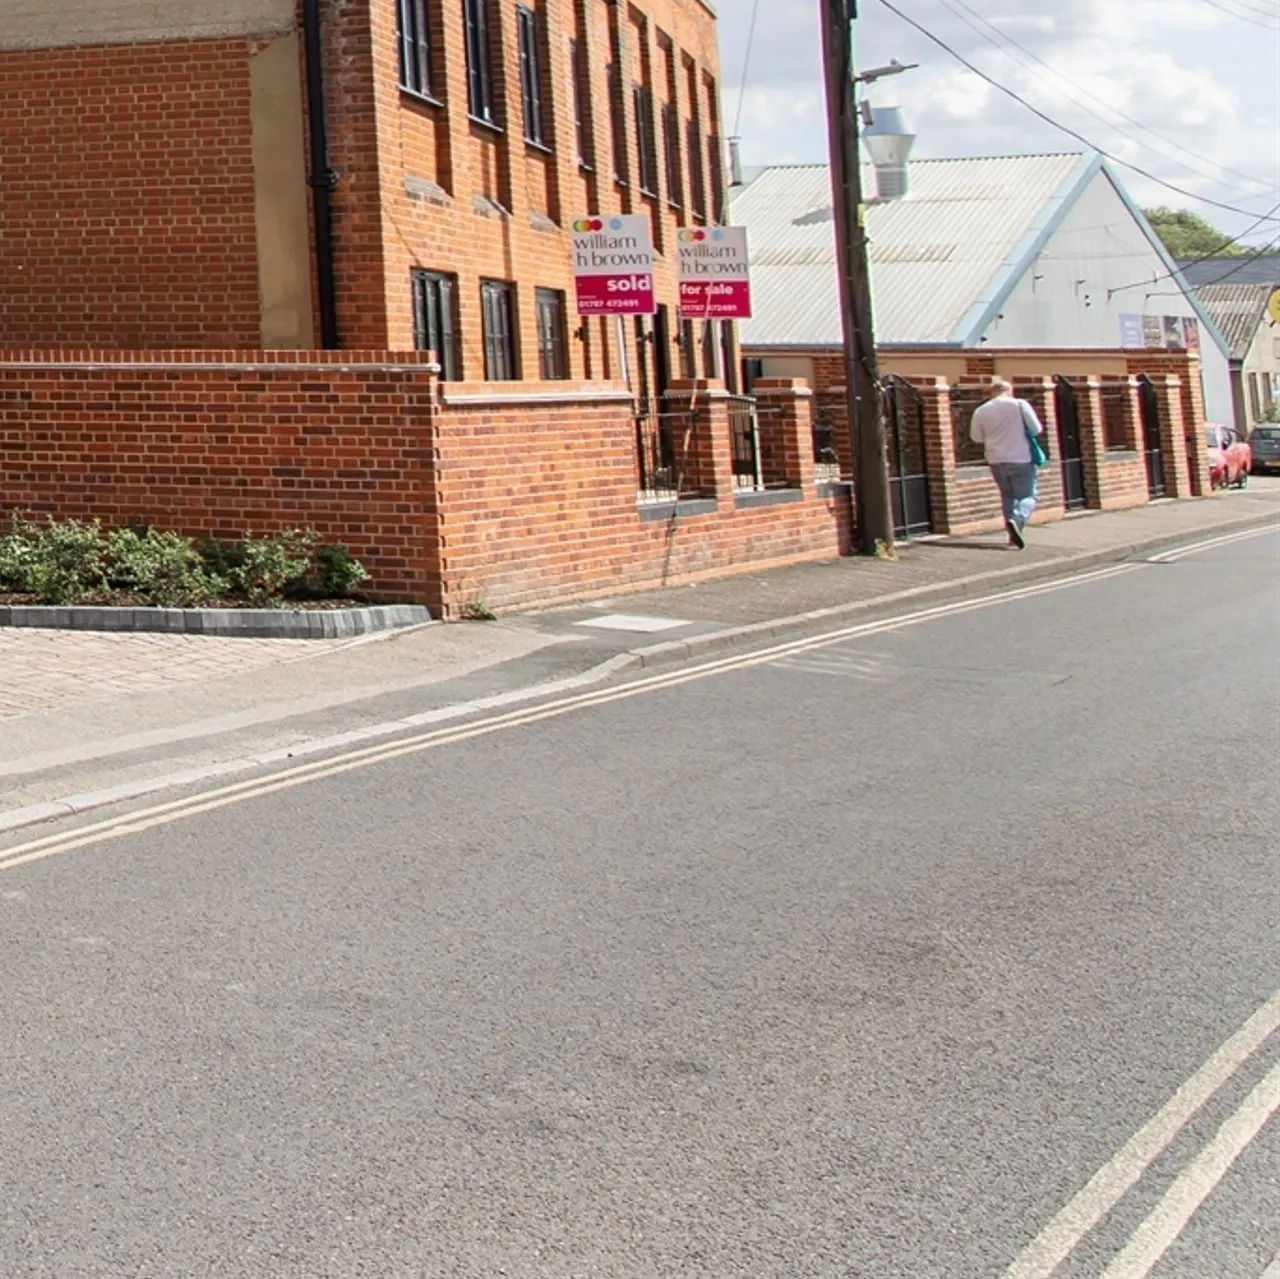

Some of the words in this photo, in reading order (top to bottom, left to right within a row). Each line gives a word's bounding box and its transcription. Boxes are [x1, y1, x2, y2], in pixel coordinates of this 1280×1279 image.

[574, 233, 637, 249] william
[576, 252, 587, 266] h
[592, 251, 649, 266] brown
[680, 245, 736, 258] william
[682, 260, 691, 274] h
[695, 260, 748, 274] brown
[607, 274, 651, 292] sold
[681, 283, 701, 295] for
[705, 283, 734, 295] sale
